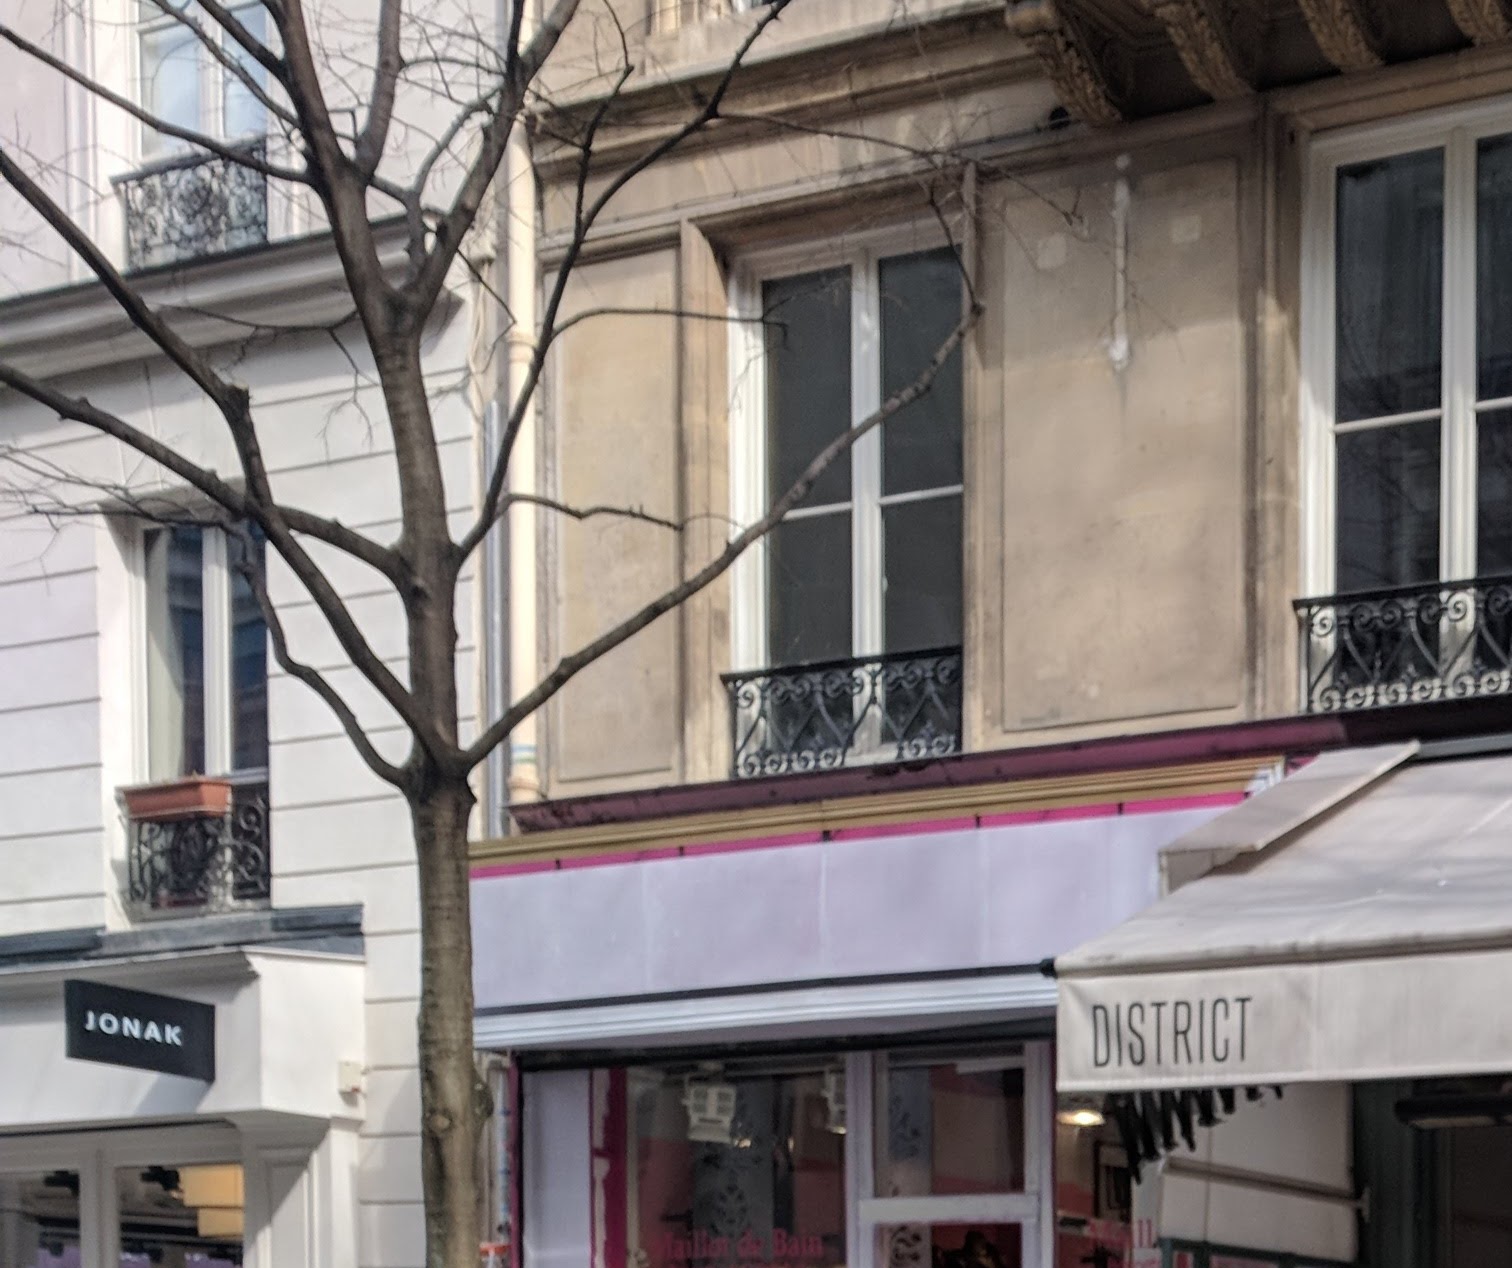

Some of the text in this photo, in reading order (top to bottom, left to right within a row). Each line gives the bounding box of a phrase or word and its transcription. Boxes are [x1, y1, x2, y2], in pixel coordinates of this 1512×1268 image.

[85, 1010, 183, 1047] JONAK
[1093, 996, 1252, 1067] DISTRICT
[772, 1228, 824, 1258] Bain
